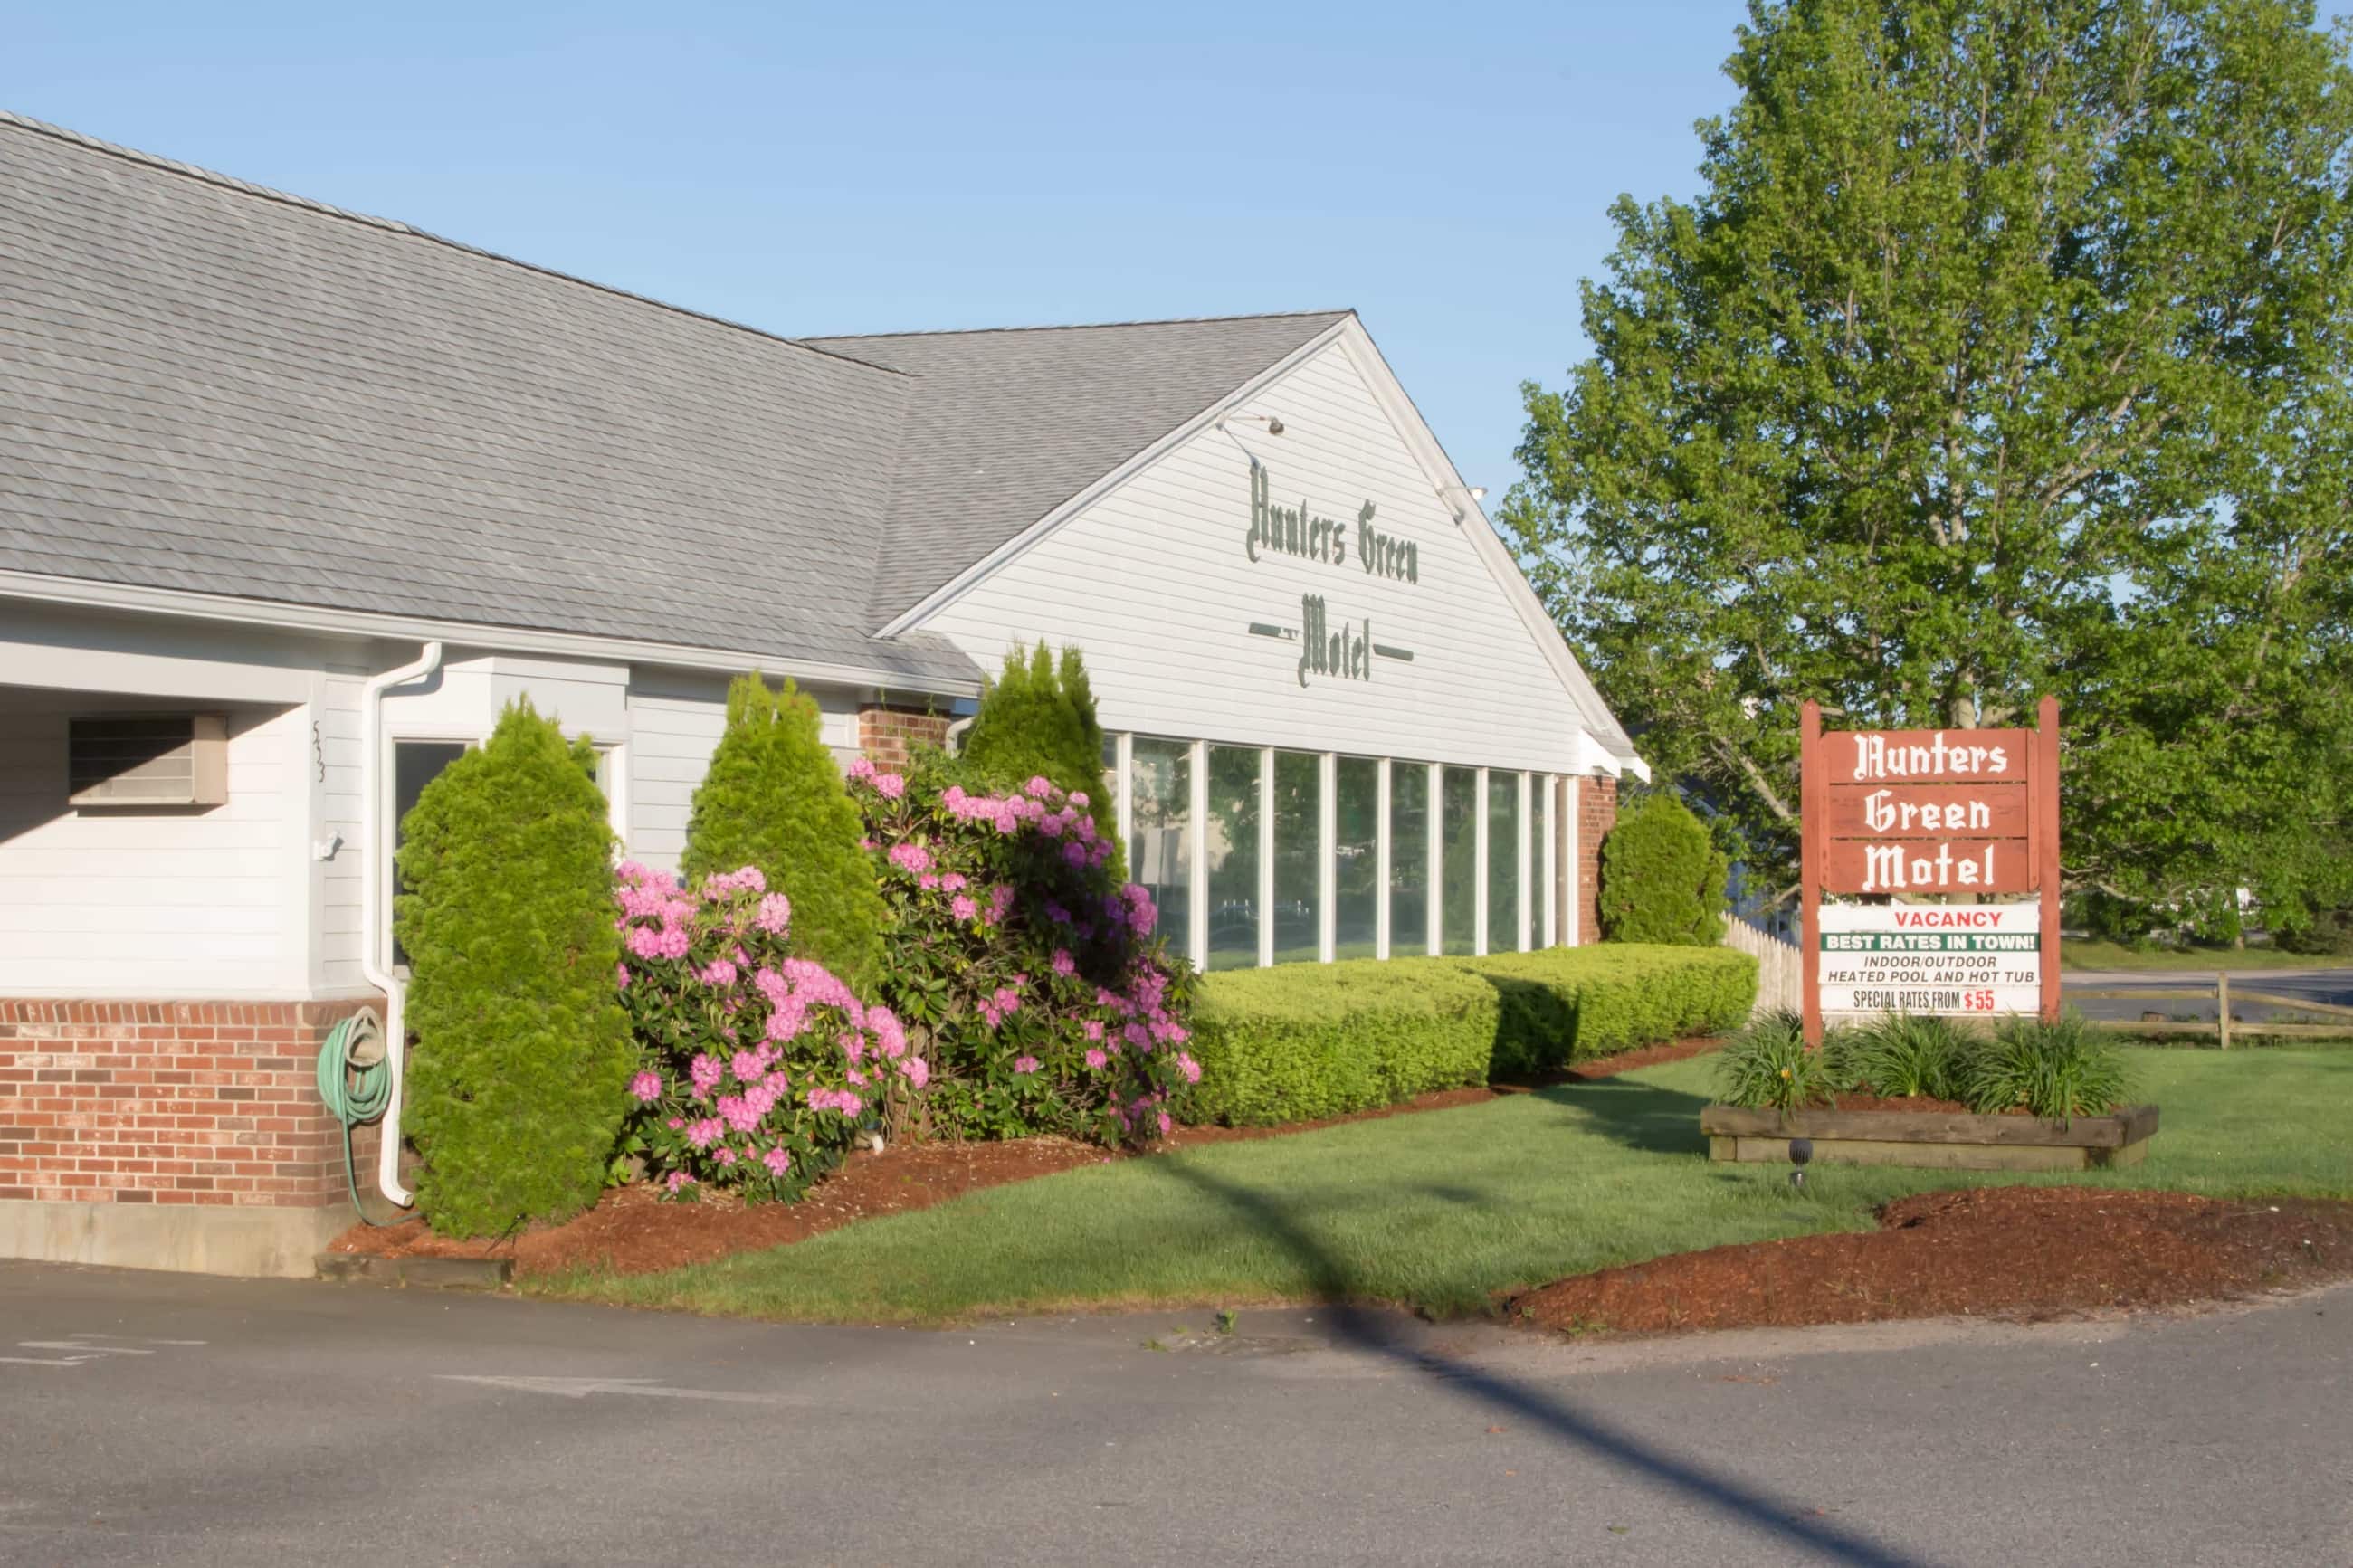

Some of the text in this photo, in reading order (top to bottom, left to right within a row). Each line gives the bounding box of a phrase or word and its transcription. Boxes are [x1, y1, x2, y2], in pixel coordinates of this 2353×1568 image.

[1246, 464, 1418, 584] Hunters Green
[1298, 593, 1370, 688] Motel
[1853, 732, 2008, 780] Hunters
[1864, 789, 1991, 832] Green
[1862, 843, 1994, 891] Motel
[1894, 911, 2003, 927] VACANCY
[1826, 935, 2035, 950] BEST RATES IN TOWN!
[1828, 971, 2034, 983] HEATED POOL AND HOT TUB
[1863, 955, 1996, 968] INDOOR/OUTDOOR
[1853, 989, 1995, 1011] SPECIAL RATES FROM $55
